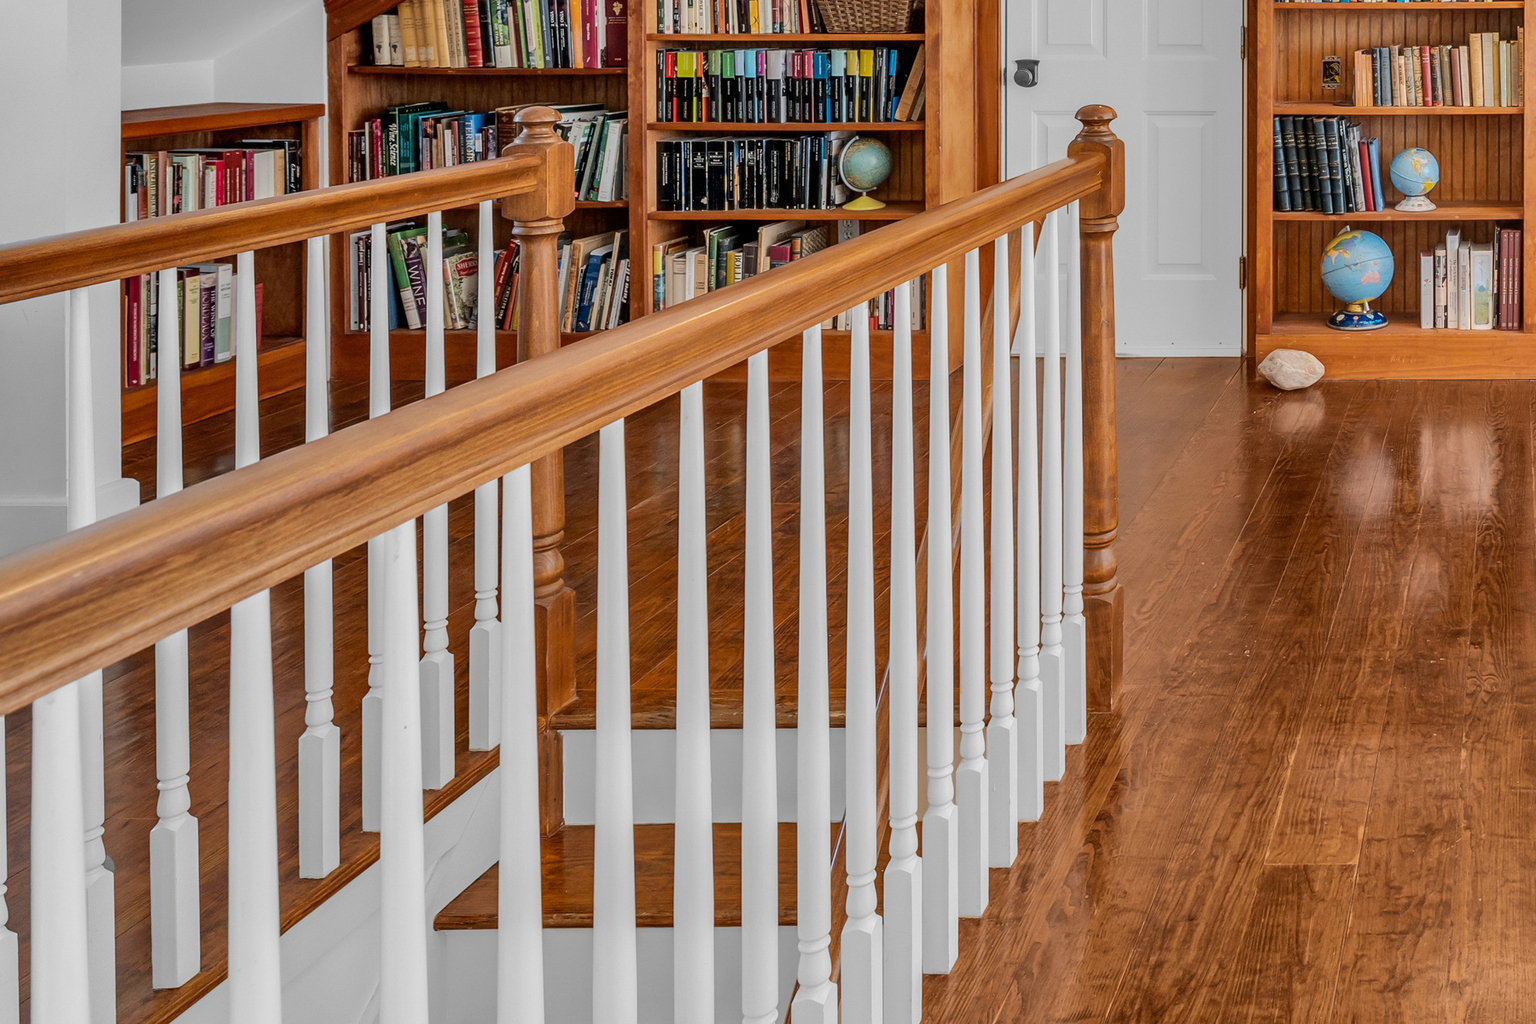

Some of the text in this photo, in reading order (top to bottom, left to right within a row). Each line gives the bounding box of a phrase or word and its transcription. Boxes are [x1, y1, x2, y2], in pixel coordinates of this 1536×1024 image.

[388, 123, 397, 166] Wine Science
[465, 119, 475, 162] TERROIR
[408, 264, 426, 306] WINE
[202, 290, 210, 340] BORDEAUX
